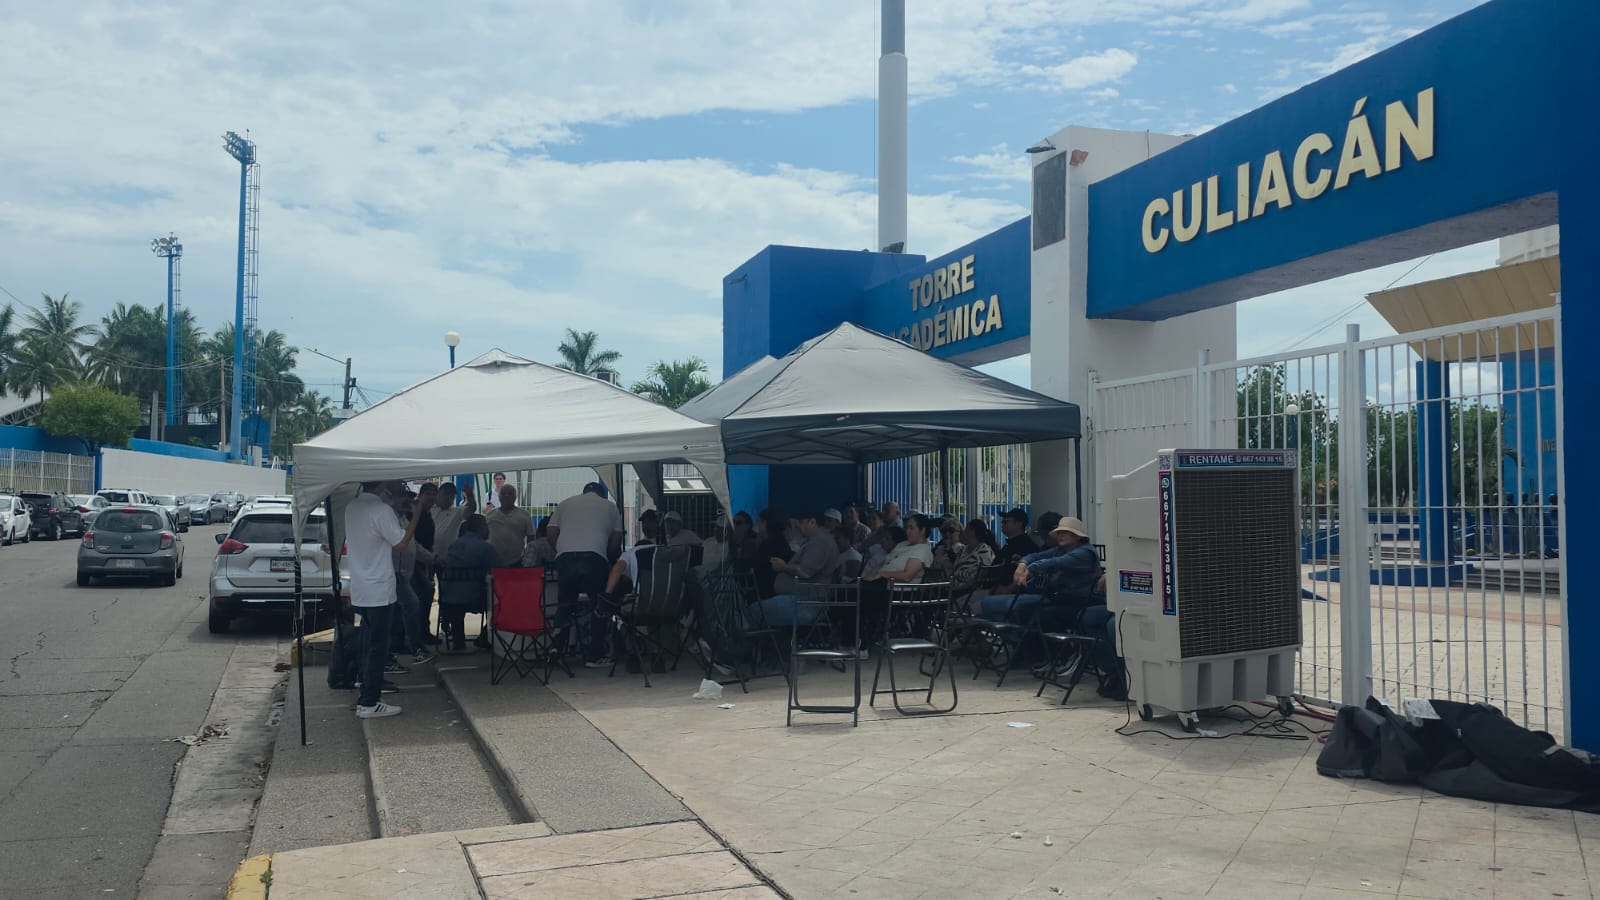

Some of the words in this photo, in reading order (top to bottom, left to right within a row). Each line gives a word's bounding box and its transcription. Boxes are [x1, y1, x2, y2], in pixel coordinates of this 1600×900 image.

[1142, 87, 1434, 253] CULIACÁN
[909, 255, 975, 311] TORRE
[889, 294, 1002, 351] CADÉMICA
[1189, 455, 1233, 464] RENTAME
